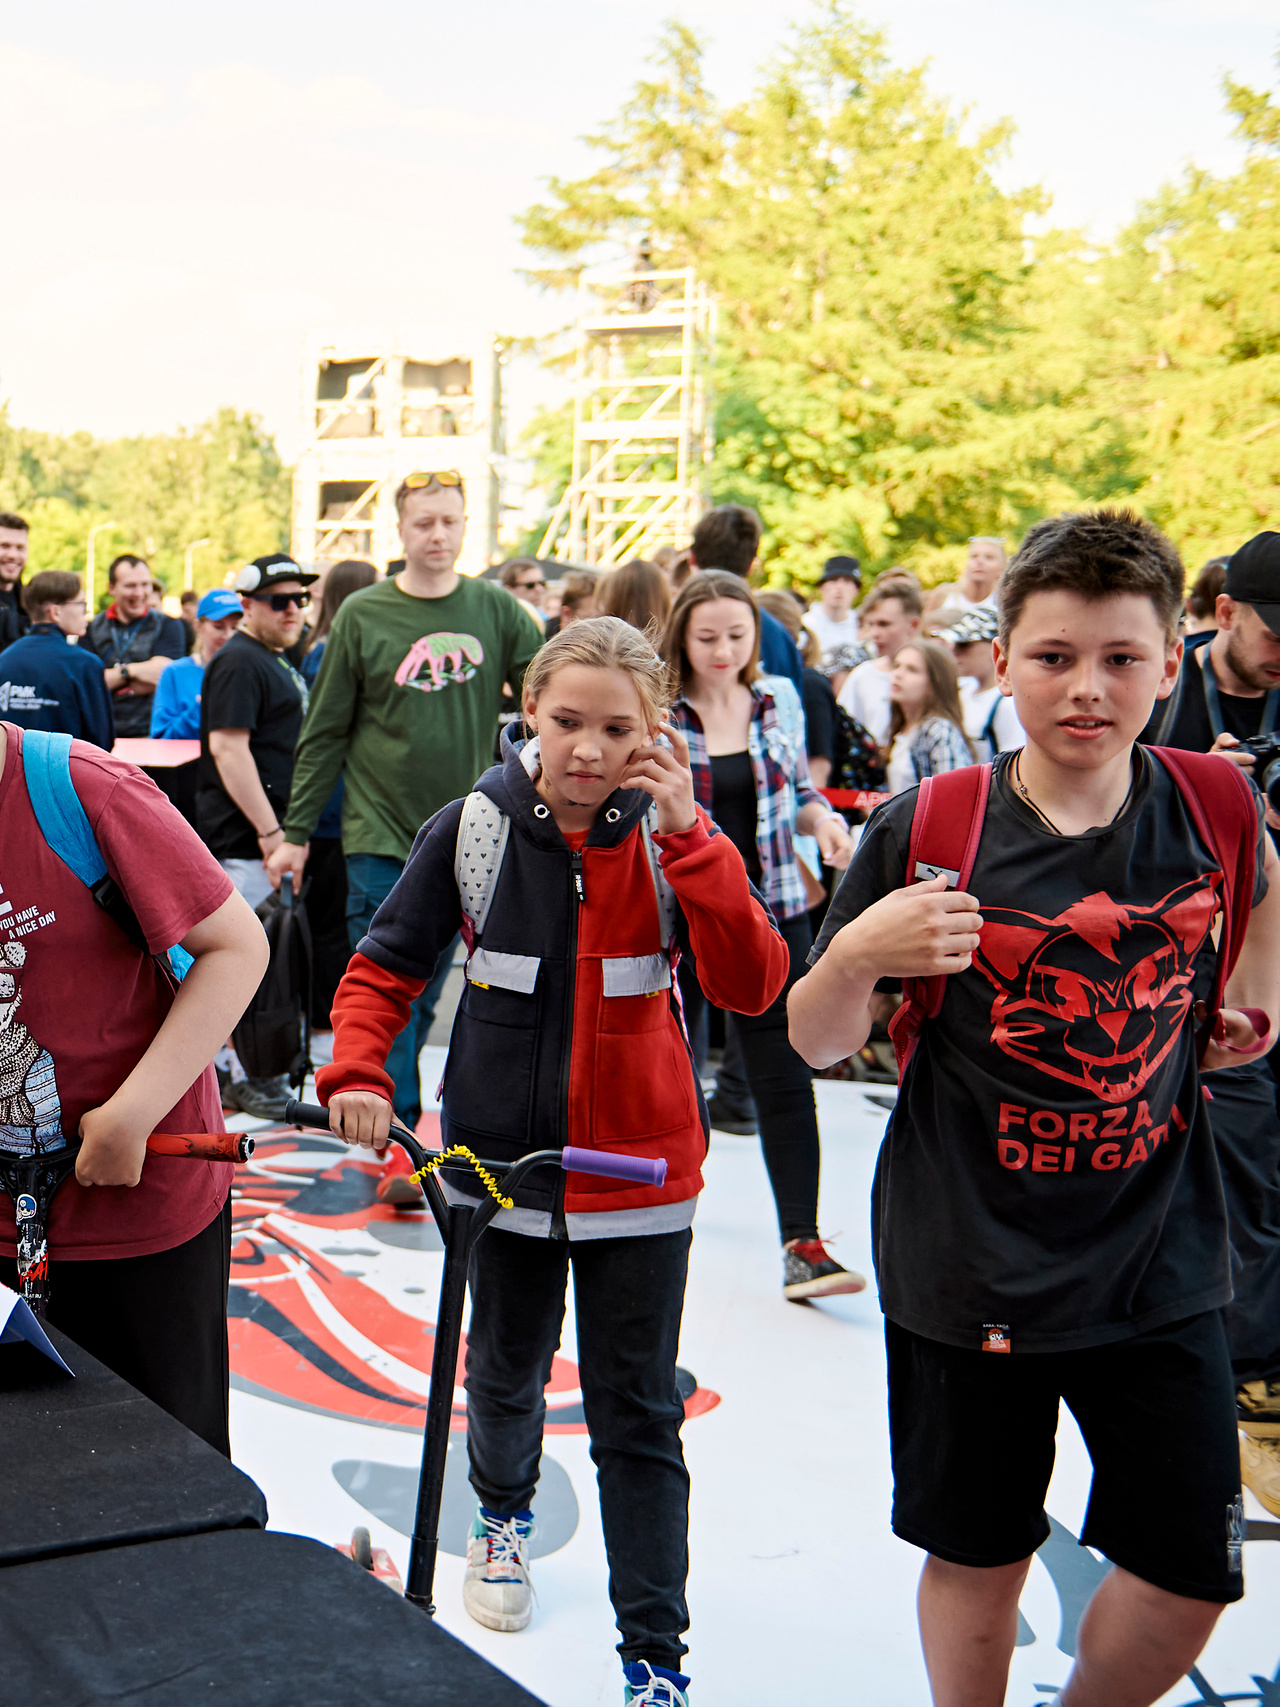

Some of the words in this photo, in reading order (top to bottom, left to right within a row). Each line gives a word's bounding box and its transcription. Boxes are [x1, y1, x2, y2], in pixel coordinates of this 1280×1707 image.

[7, 929, 16, 940] A
[15, 920, 39, 936] NICE
[38, 910, 57, 927] DAY
[15, 905, 40, 924] HAVE
[998, 1100, 1153, 1142] FORZA
[997, 1138, 1076, 1173] DEI
